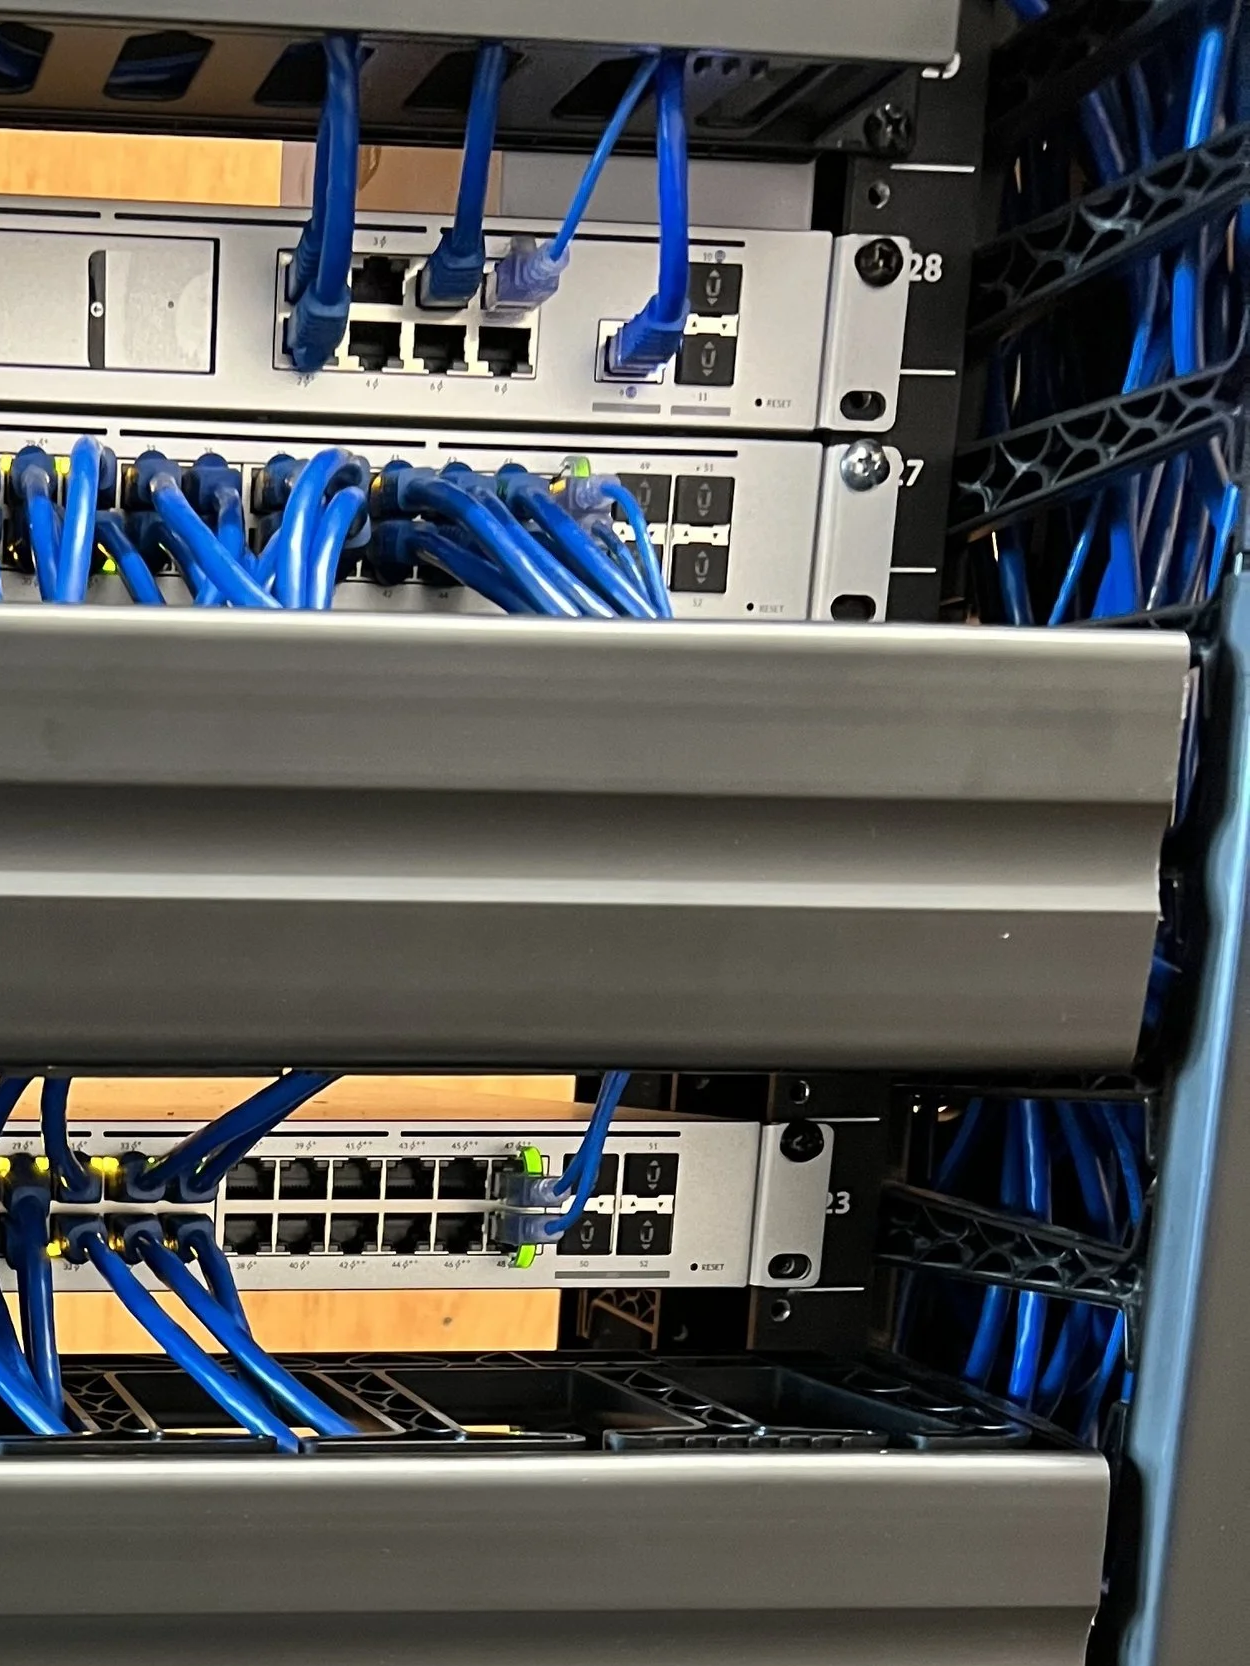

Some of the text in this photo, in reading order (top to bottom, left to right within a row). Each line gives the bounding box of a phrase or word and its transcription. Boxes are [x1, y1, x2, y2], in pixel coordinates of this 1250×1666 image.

[909, 252, 943, 282] 28
[766, 399, 791, 408] RESET
[898, 459, 925, 487] 7
[759, 605, 784, 613] RESET
[701, 1263, 724, 1271] RESET
